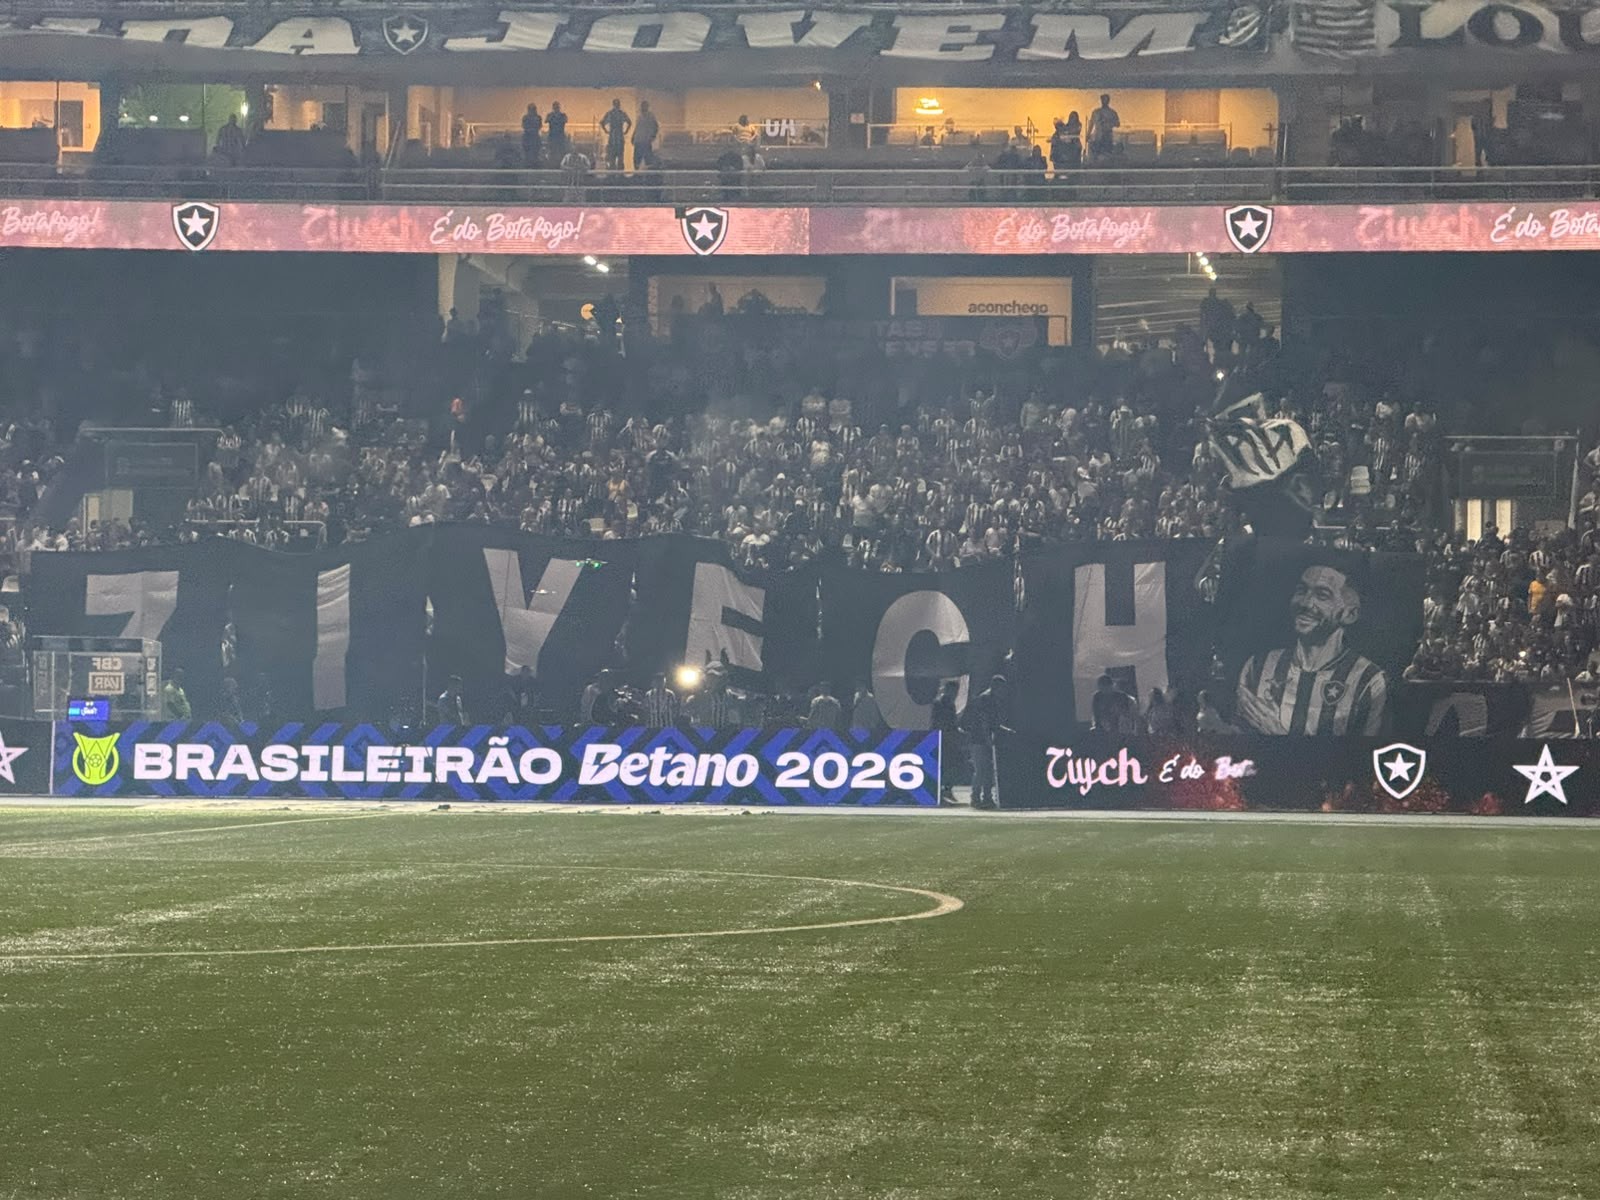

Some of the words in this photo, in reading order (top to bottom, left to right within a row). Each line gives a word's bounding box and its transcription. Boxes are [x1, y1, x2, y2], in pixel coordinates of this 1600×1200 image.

[443, 10, 1207, 61] JOVEM
[2, 206, 101, 243] Botafogo!
[429, 209, 453, 245] É
[453, 216, 482, 241] do
[486, 212, 584, 249] Botafogo!
[993, 211, 1018, 245] É
[1016, 217, 1047, 243] do
[1050, 212, 1151, 248] Botafogo!
[1490, 207, 1516, 242] É
[1515, 213, 1545, 238] do
[1549, 208, 1600, 239] Bota
[967, 301, 1049, 316] aconchego
[133, 736, 562, 784] BRASILEIRÃO
[578, 743, 759, 787] Betano
[775, 751, 925, 790] 2026
[1159, 754, 1180, 783] É
[1180, 758, 1205, 779] do
